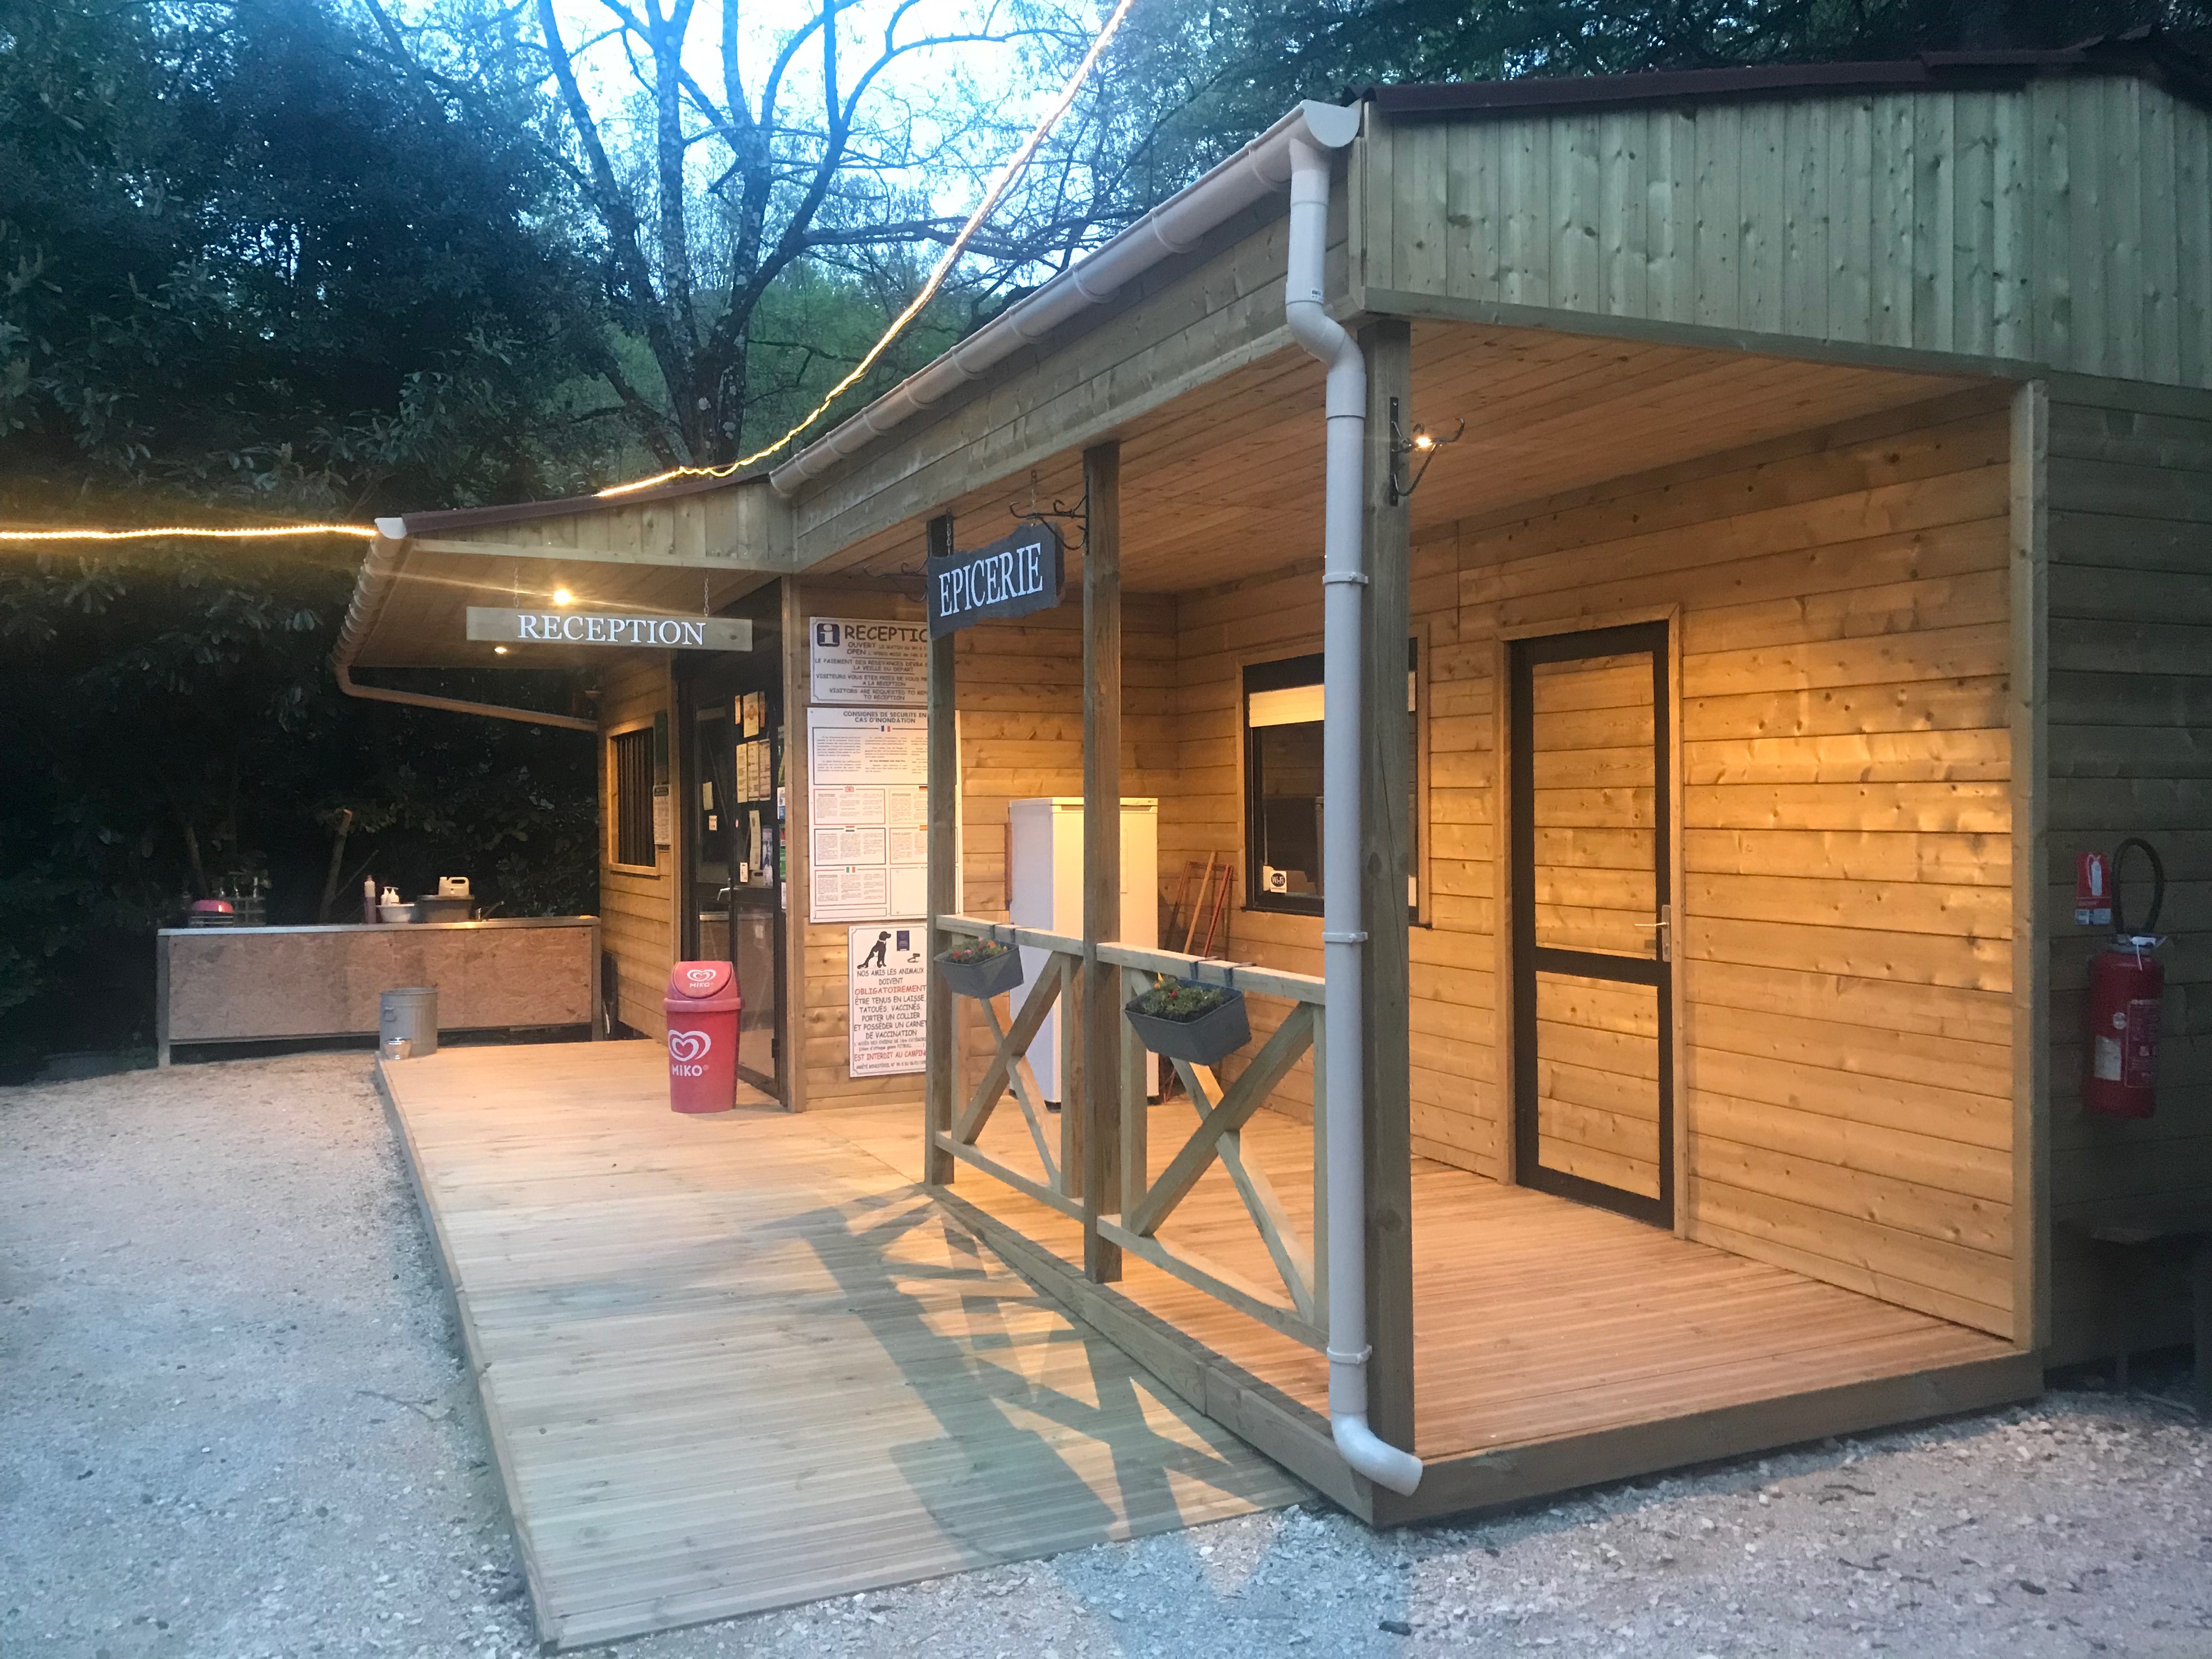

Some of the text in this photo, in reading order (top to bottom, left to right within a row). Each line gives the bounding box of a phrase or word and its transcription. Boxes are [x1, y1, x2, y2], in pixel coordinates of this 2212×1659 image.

[939, 543, 1043, 617] EPICERIE
[518, 614, 707, 645] RECEPTION
[855, 985, 927, 995] OBLIGATOIREMENT
[855, 996, 870, 1006] ÊTRE
[861, 1014, 884, 1022] PORTER
[896, 1012, 920, 1020] COLLIER
[875, 1029, 917, 1039] VACCINATION
[854, 1053, 865, 1062] EST
[867, 1052, 893, 1060] INTERDIT
[905, 1049, 927, 1057] CAMPIN
[672, 1064, 702, 1076] MIKO
